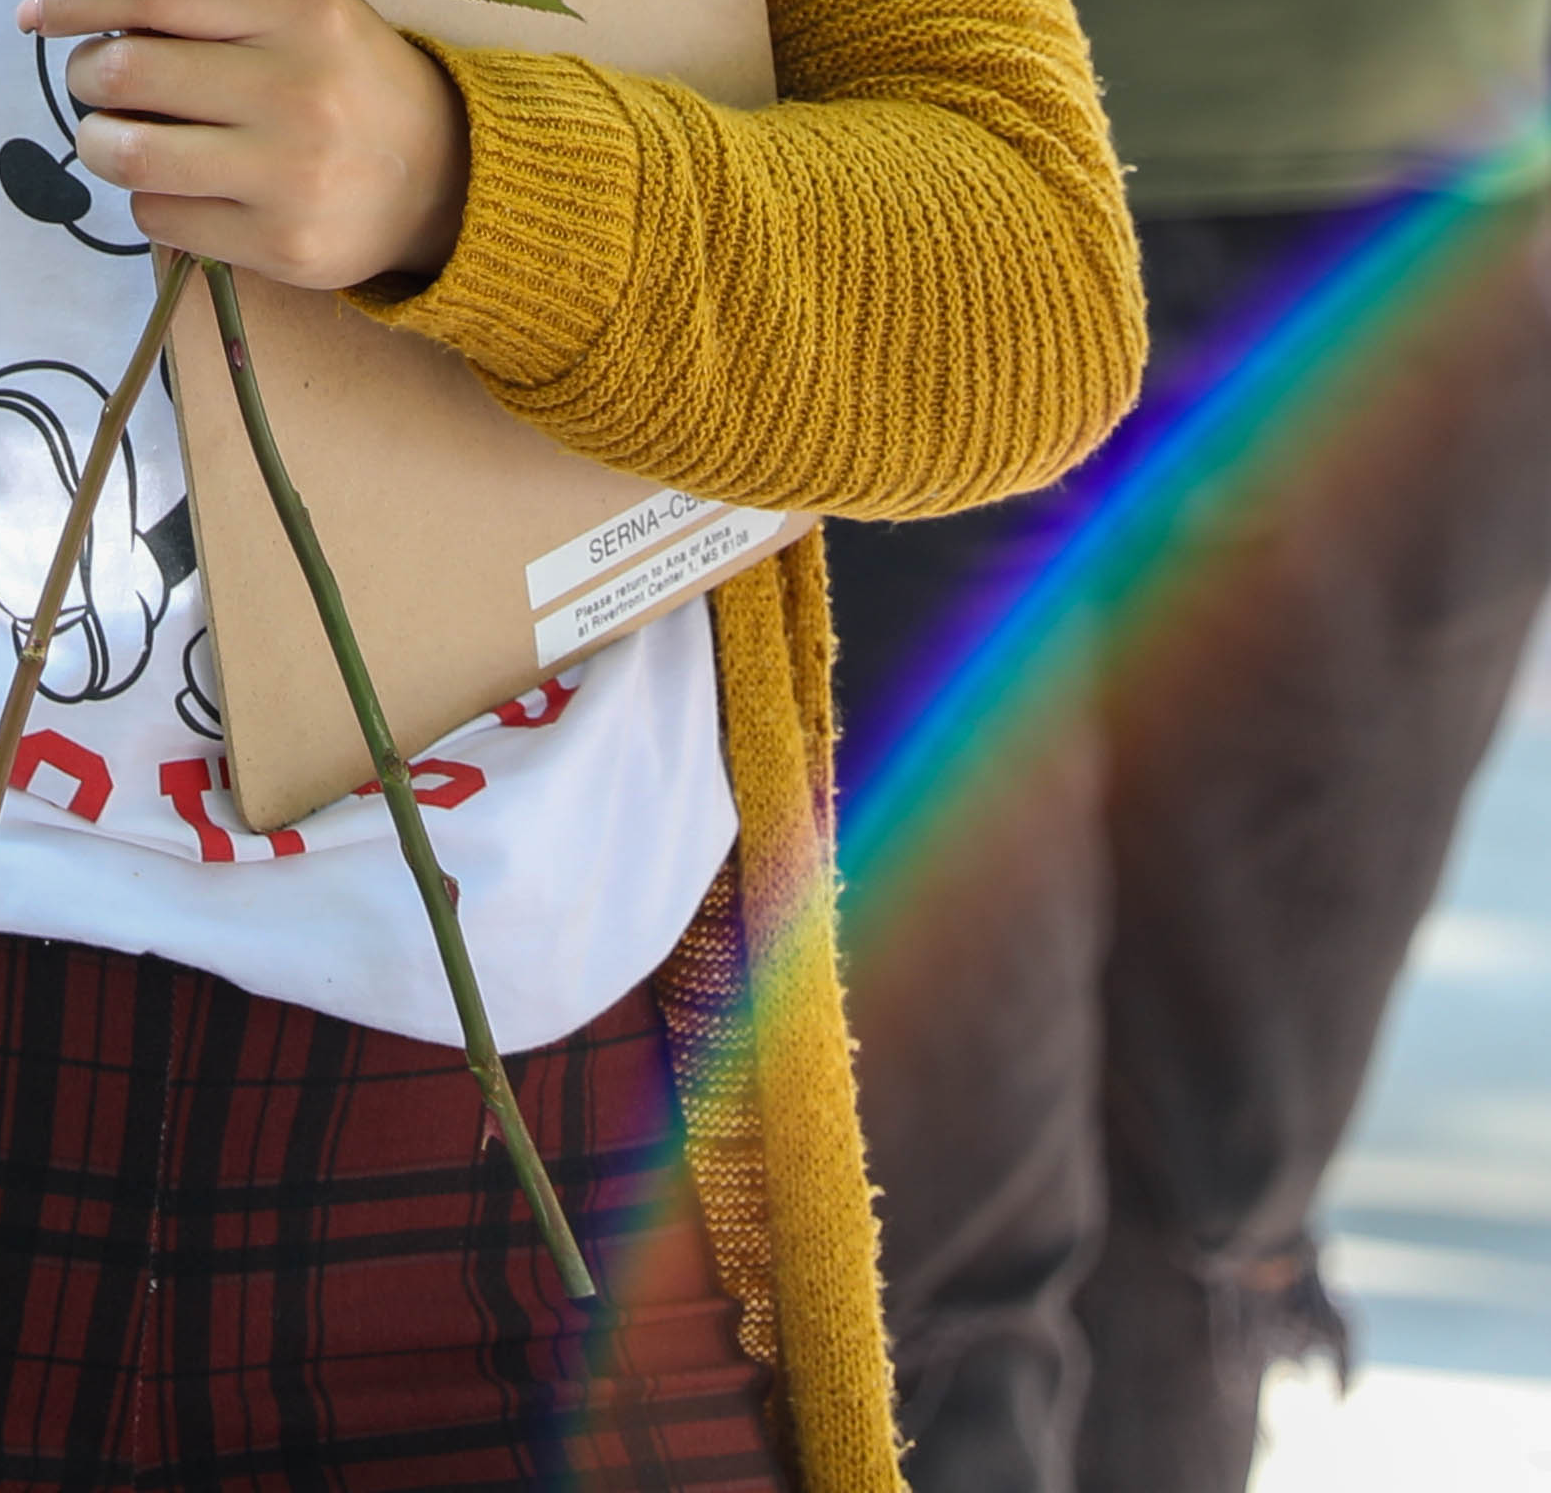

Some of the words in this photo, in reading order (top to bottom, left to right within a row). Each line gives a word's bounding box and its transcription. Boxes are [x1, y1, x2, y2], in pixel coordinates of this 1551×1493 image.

[575, 595, 612, 621] Please
[615, 574, 648, 598] return
[651, 565, 663, 579] to
[666, 551, 687, 568] Ana
[690, 543, 701, 555] or
[703, 526, 732, 547] Alma
[589, 493, 707, 564] SERNA-CB
[578, 623, 589, 638] at
[591, 590, 646, 627] Riverfront
[648, 570, 684, 597] Center
[701, 547, 719, 565] MS
